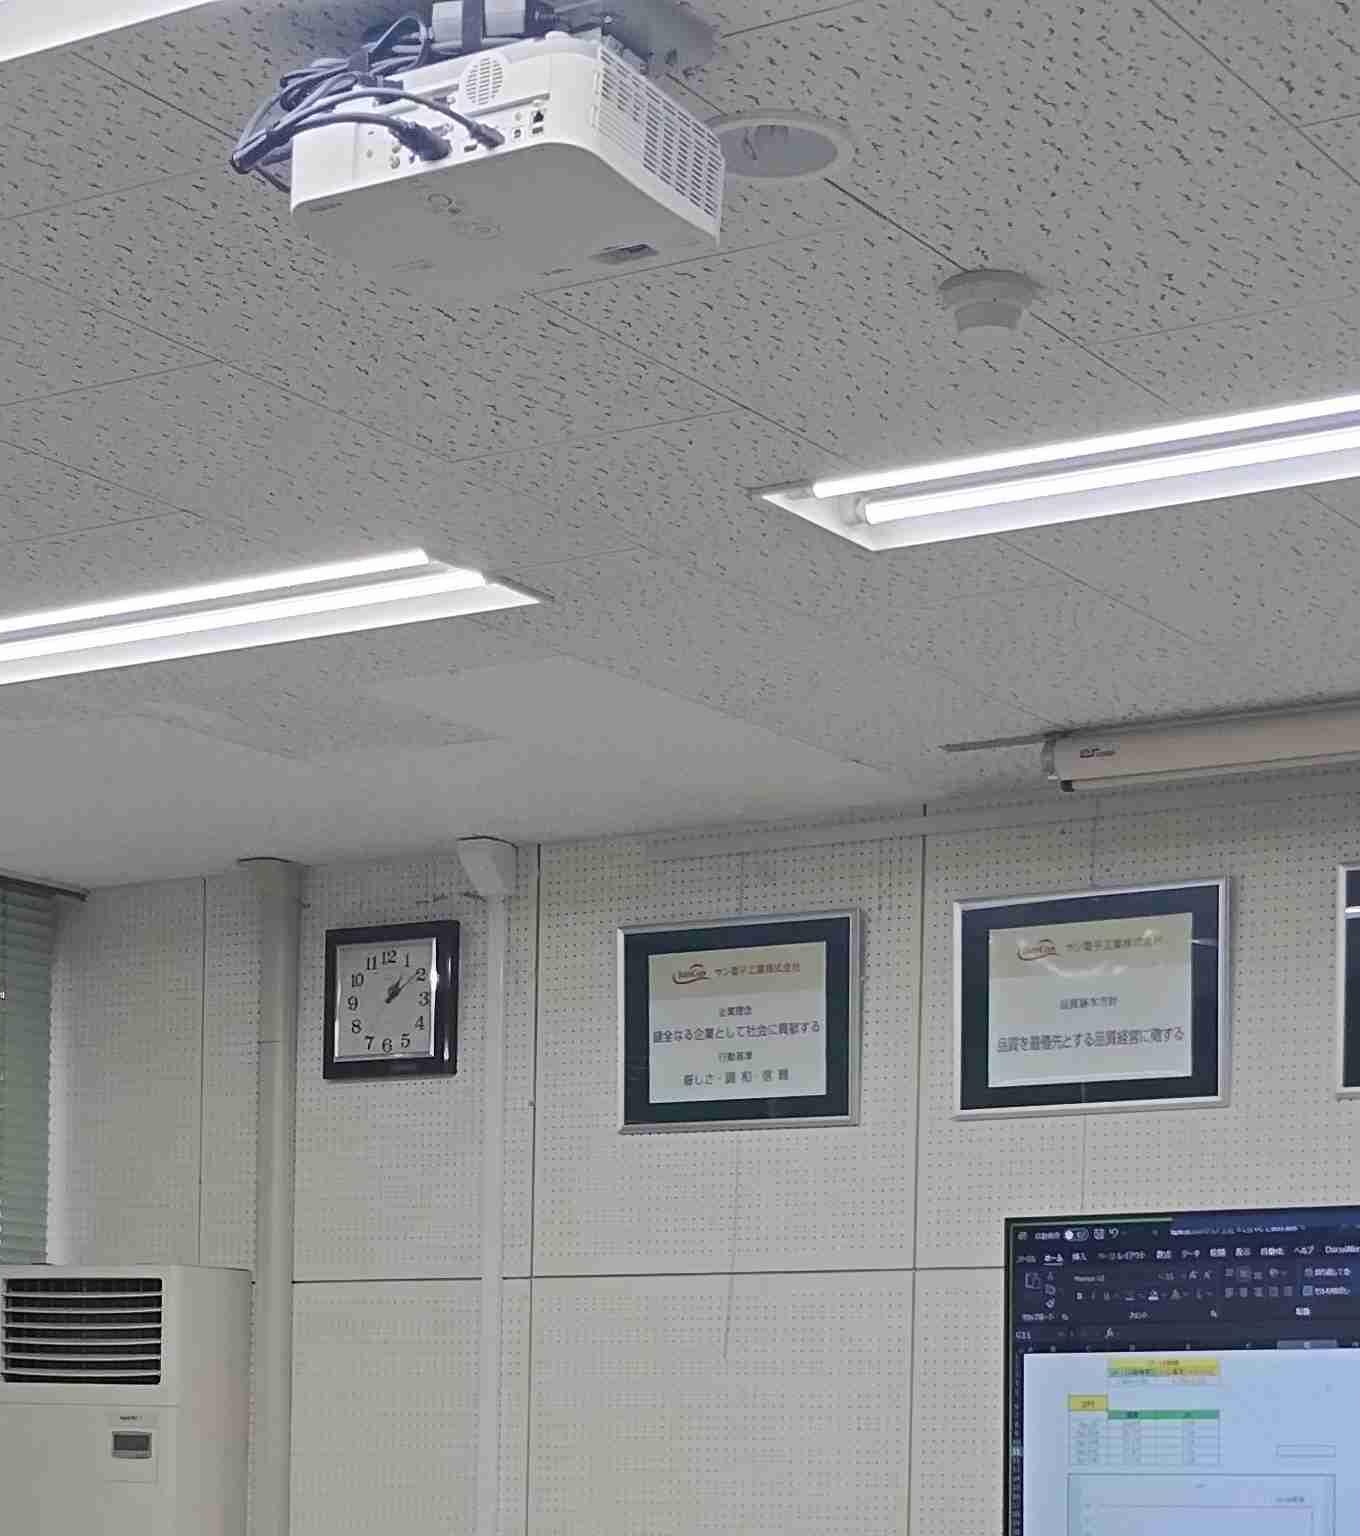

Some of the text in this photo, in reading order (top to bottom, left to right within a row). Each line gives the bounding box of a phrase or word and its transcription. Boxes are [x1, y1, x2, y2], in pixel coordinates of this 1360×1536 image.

[366, 955, 377, 971] 11
[381, 950, 397, 966] 12
[351, 972, 364, 988] 10
[415, 967, 426, 982] 2
[347, 995, 358, 1011] 9
[418, 991, 430, 1007] 3
[351, 1019, 362, 1034] 8
[414, 1015, 425, 1031] 4
[364, 1035, 375, 1051] 7
[381, 1038, 393, 1053] 6
[400, 1033, 410, 1048] 5
